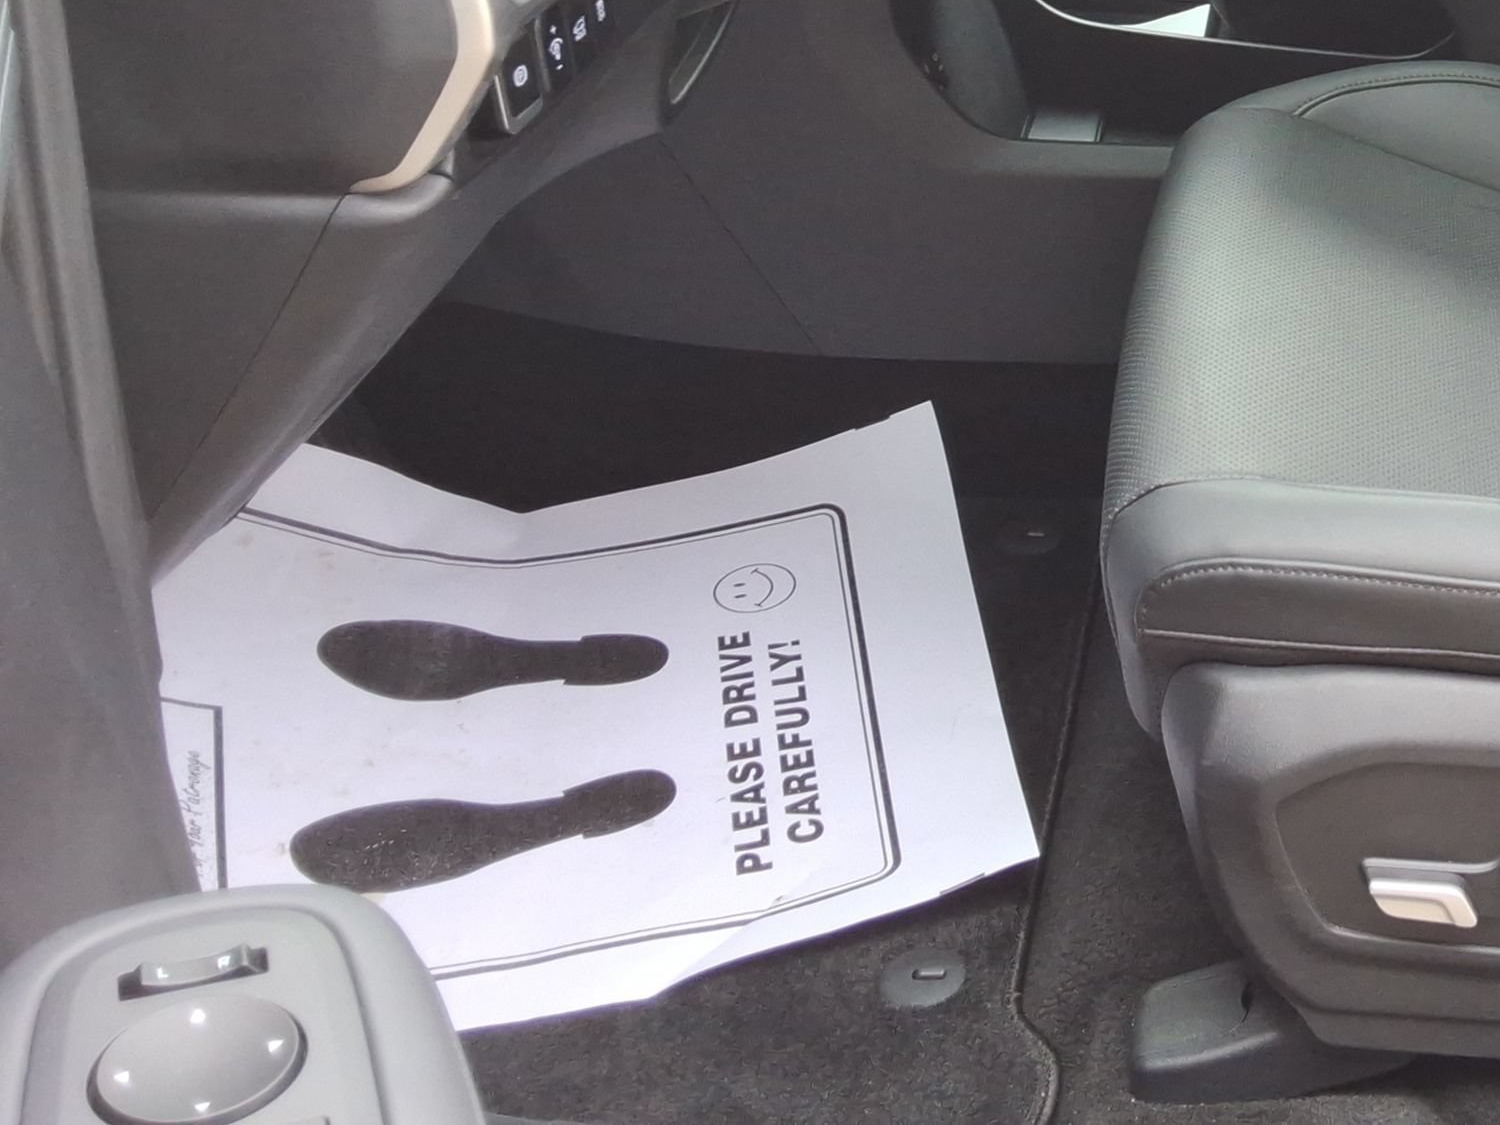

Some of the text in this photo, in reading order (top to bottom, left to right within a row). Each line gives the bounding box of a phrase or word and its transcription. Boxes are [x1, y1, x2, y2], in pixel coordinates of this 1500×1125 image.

[178, 750, 211, 817] Patronage
[717, 631, 774, 876] PLEASE DRIVE
[767, 639, 825, 844] CAREFULLY!
[157, 967, 169, 979] L
